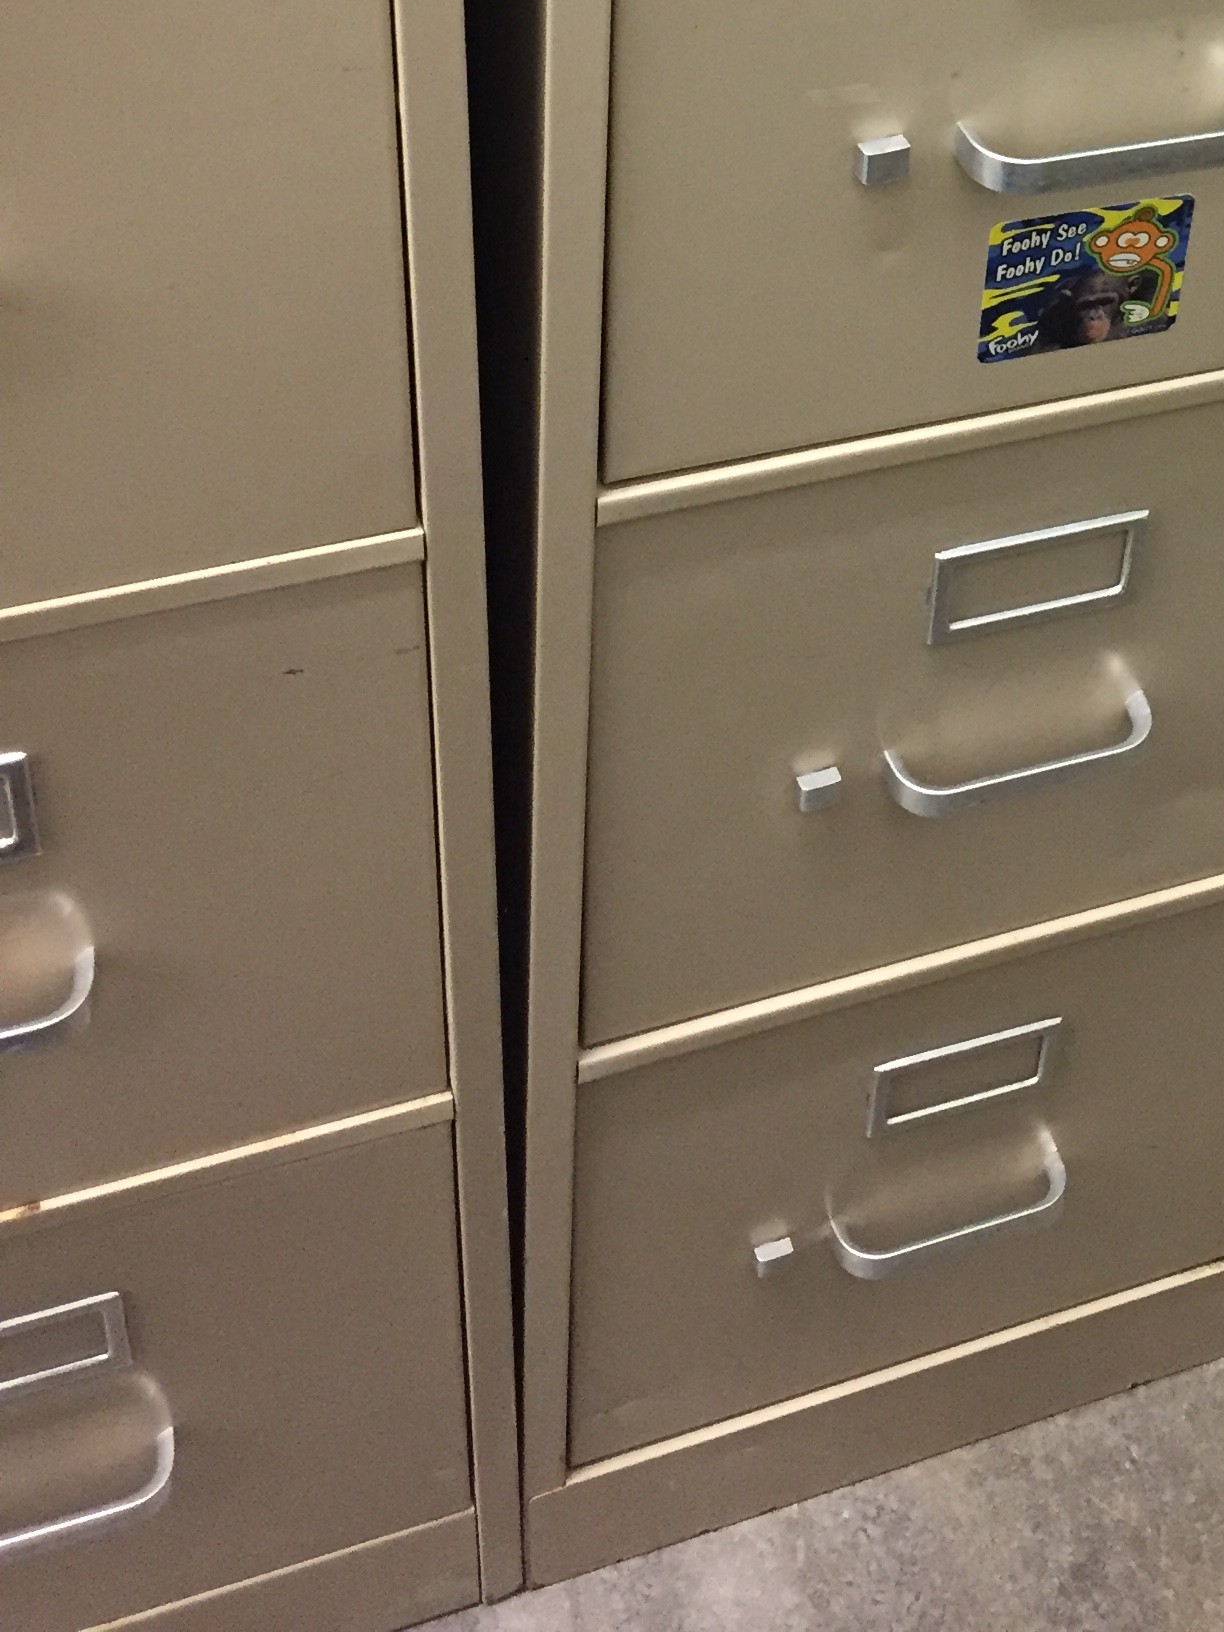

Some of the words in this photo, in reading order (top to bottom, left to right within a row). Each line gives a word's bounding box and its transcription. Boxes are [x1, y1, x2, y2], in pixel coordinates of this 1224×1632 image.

[1001, 230, 1052, 257] Foohy
[1056, 223, 1088, 242] See
[995, 256, 1046, 282] Foohy
[1049, 242, 1082, 267] Do!
[987, 329, 1040, 356] Foohy
